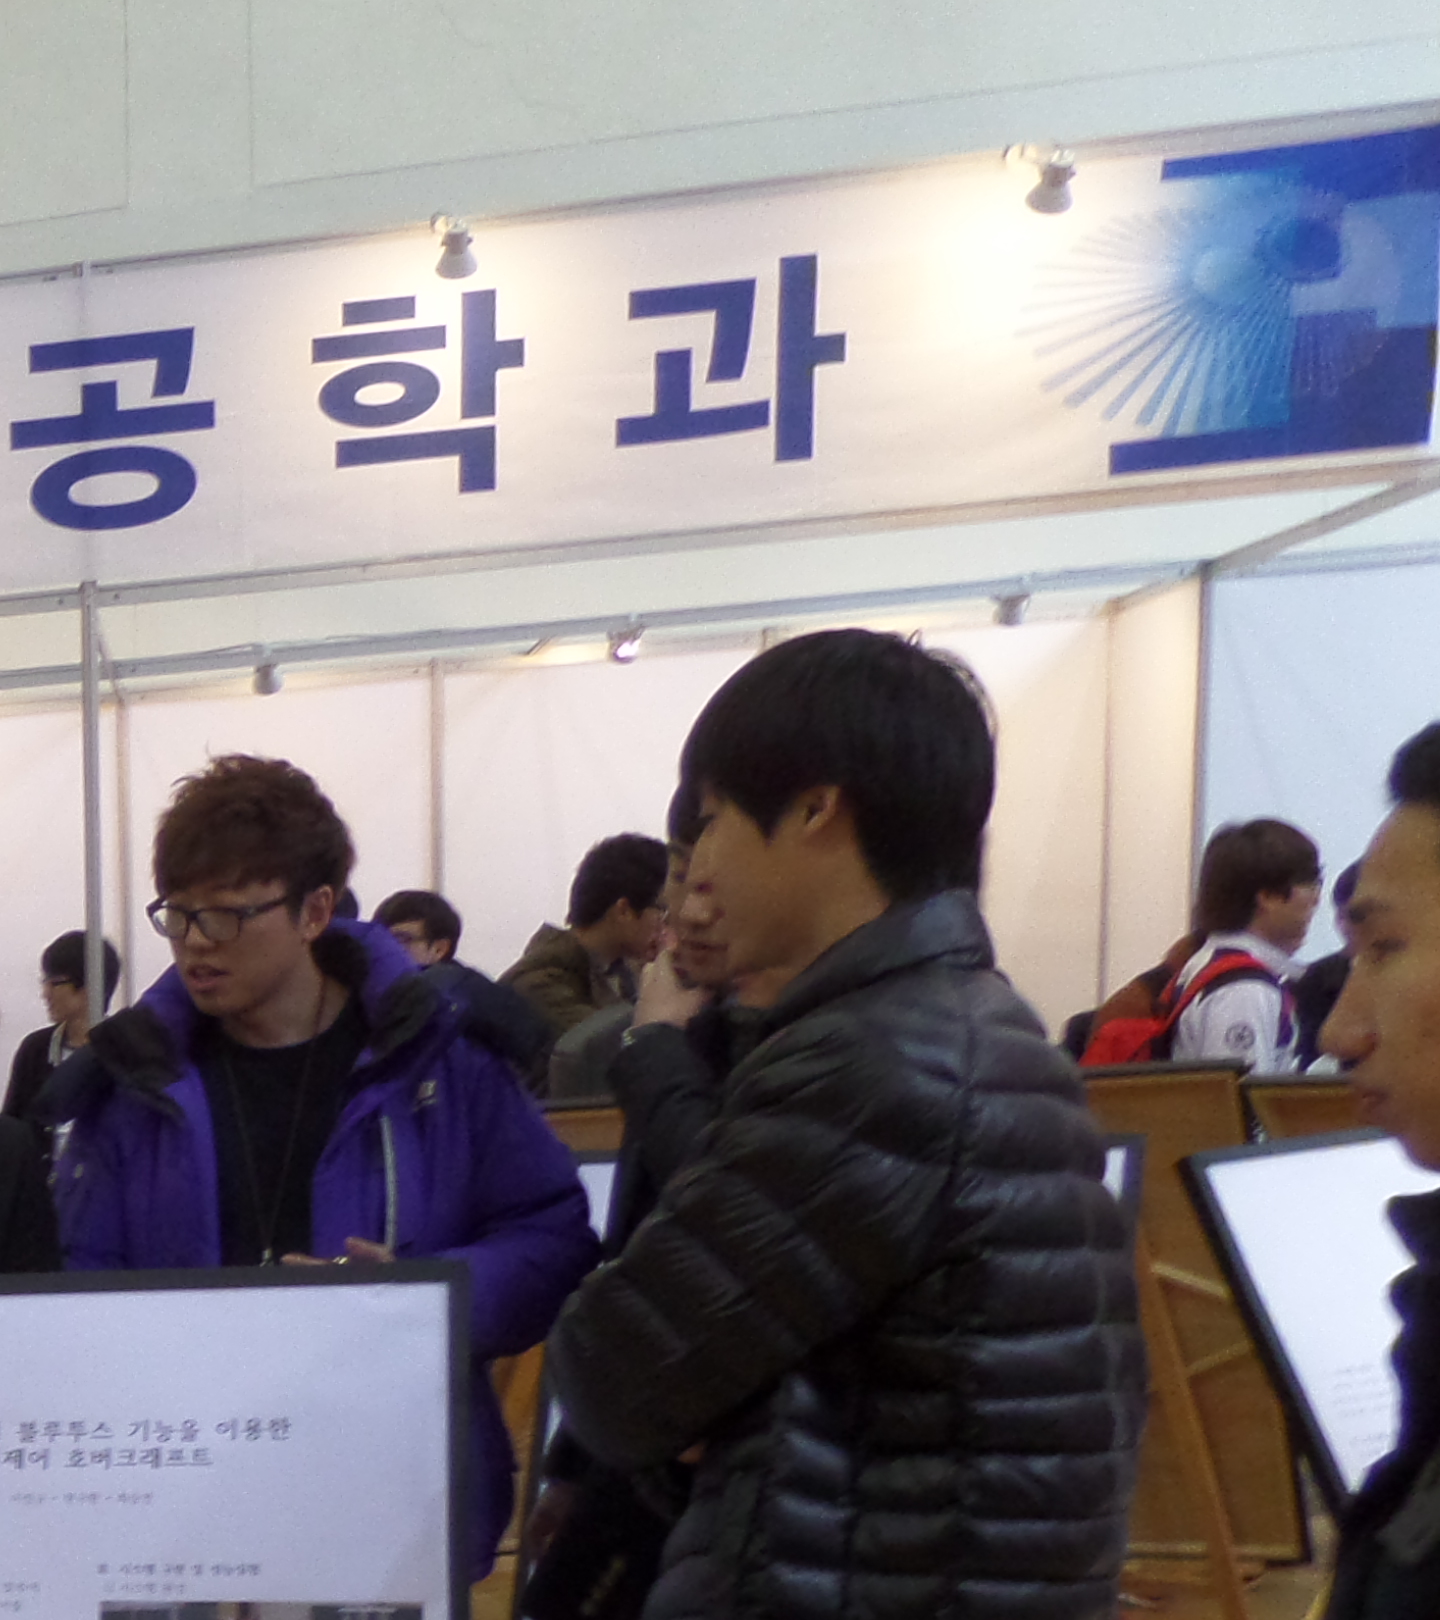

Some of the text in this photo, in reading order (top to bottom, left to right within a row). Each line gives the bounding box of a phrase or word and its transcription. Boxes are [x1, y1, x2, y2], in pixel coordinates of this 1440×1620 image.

[16, 1420, 114, 1443] 블루투스
[127, 1418, 200, 1443] 기능을
[214, 1416, 292, 1442] 이용한
[63, 1446, 215, 1470] 호버크래프트
